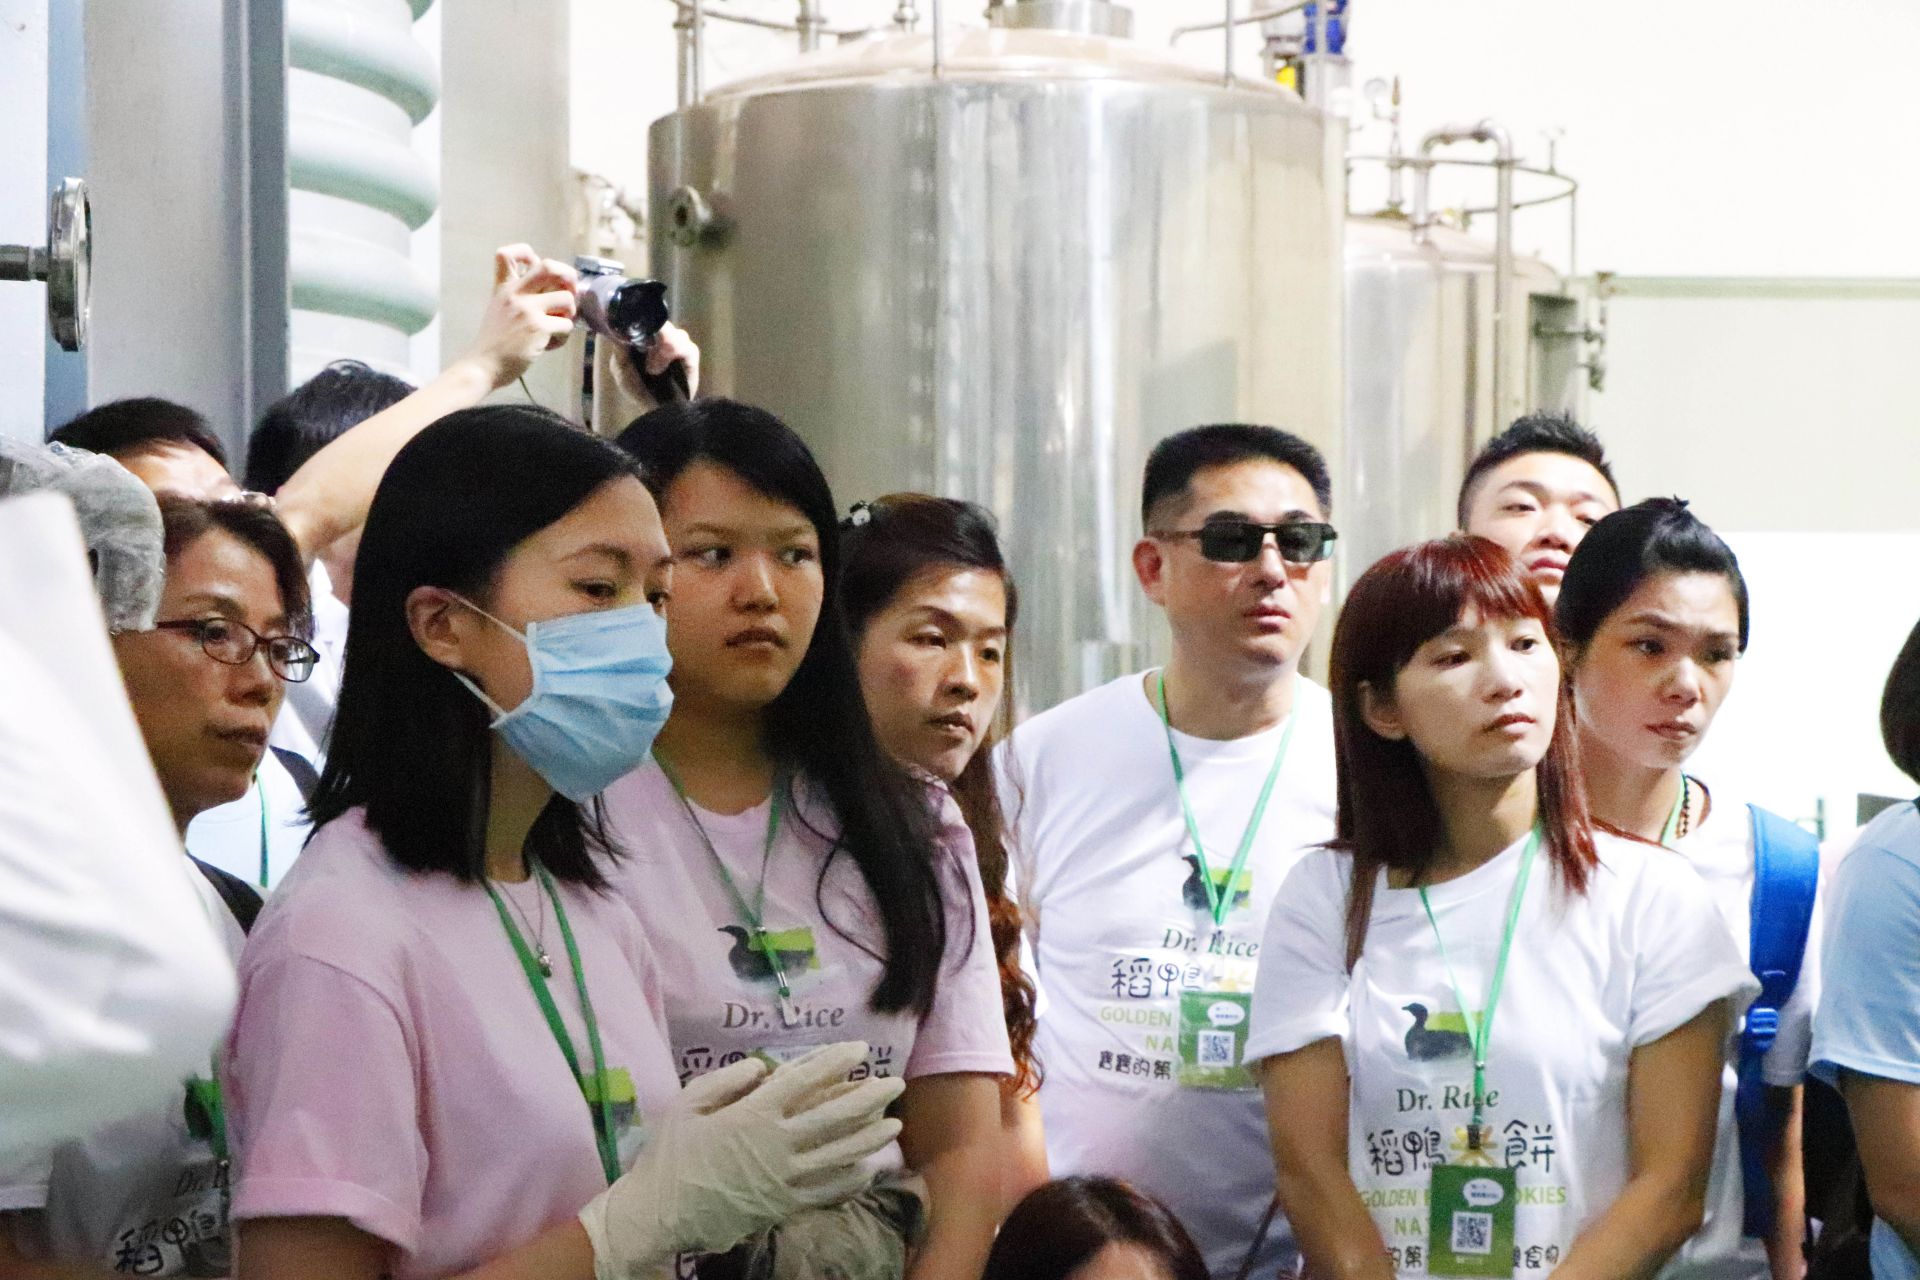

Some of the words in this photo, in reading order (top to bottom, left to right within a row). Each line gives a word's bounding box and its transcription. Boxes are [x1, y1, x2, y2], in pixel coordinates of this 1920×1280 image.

[1161, 928, 1198, 952] Dr.
[722, 1002, 770, 1030] Dr.
[1101, 1006, 1172, 1027] GOLDEN
[1146, 1035, 1174, 1052] NA
[1397, 1088, 1432, 1112] Dr.
[1503, 1119, 1555, 1173] 餅
[1514, 1186, 1567, 1205] OKIES
[1394, 1217, 1424, 1236] NA
